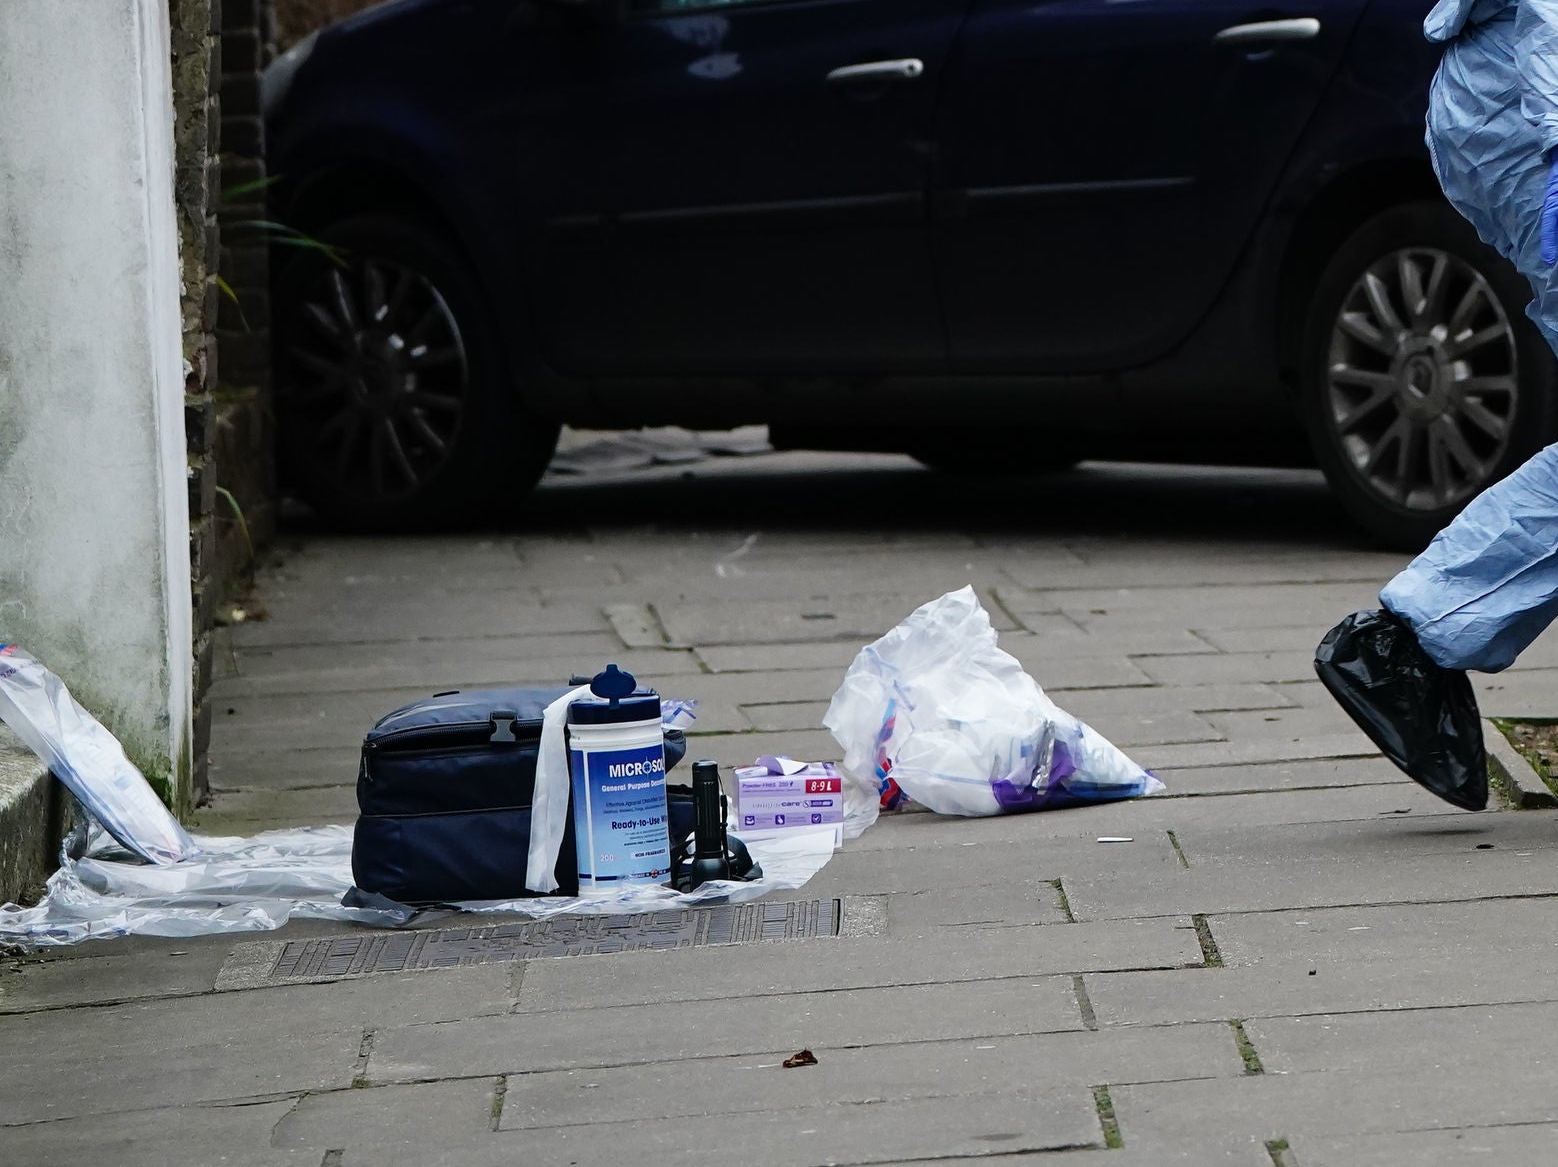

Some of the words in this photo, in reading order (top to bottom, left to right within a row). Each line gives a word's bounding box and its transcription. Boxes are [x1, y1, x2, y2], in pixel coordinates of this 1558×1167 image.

[601, 784, 626, 793] General
[627, 781, 650, 791] Purpose
[611, 816, 660, 831] Ready-to-Use
